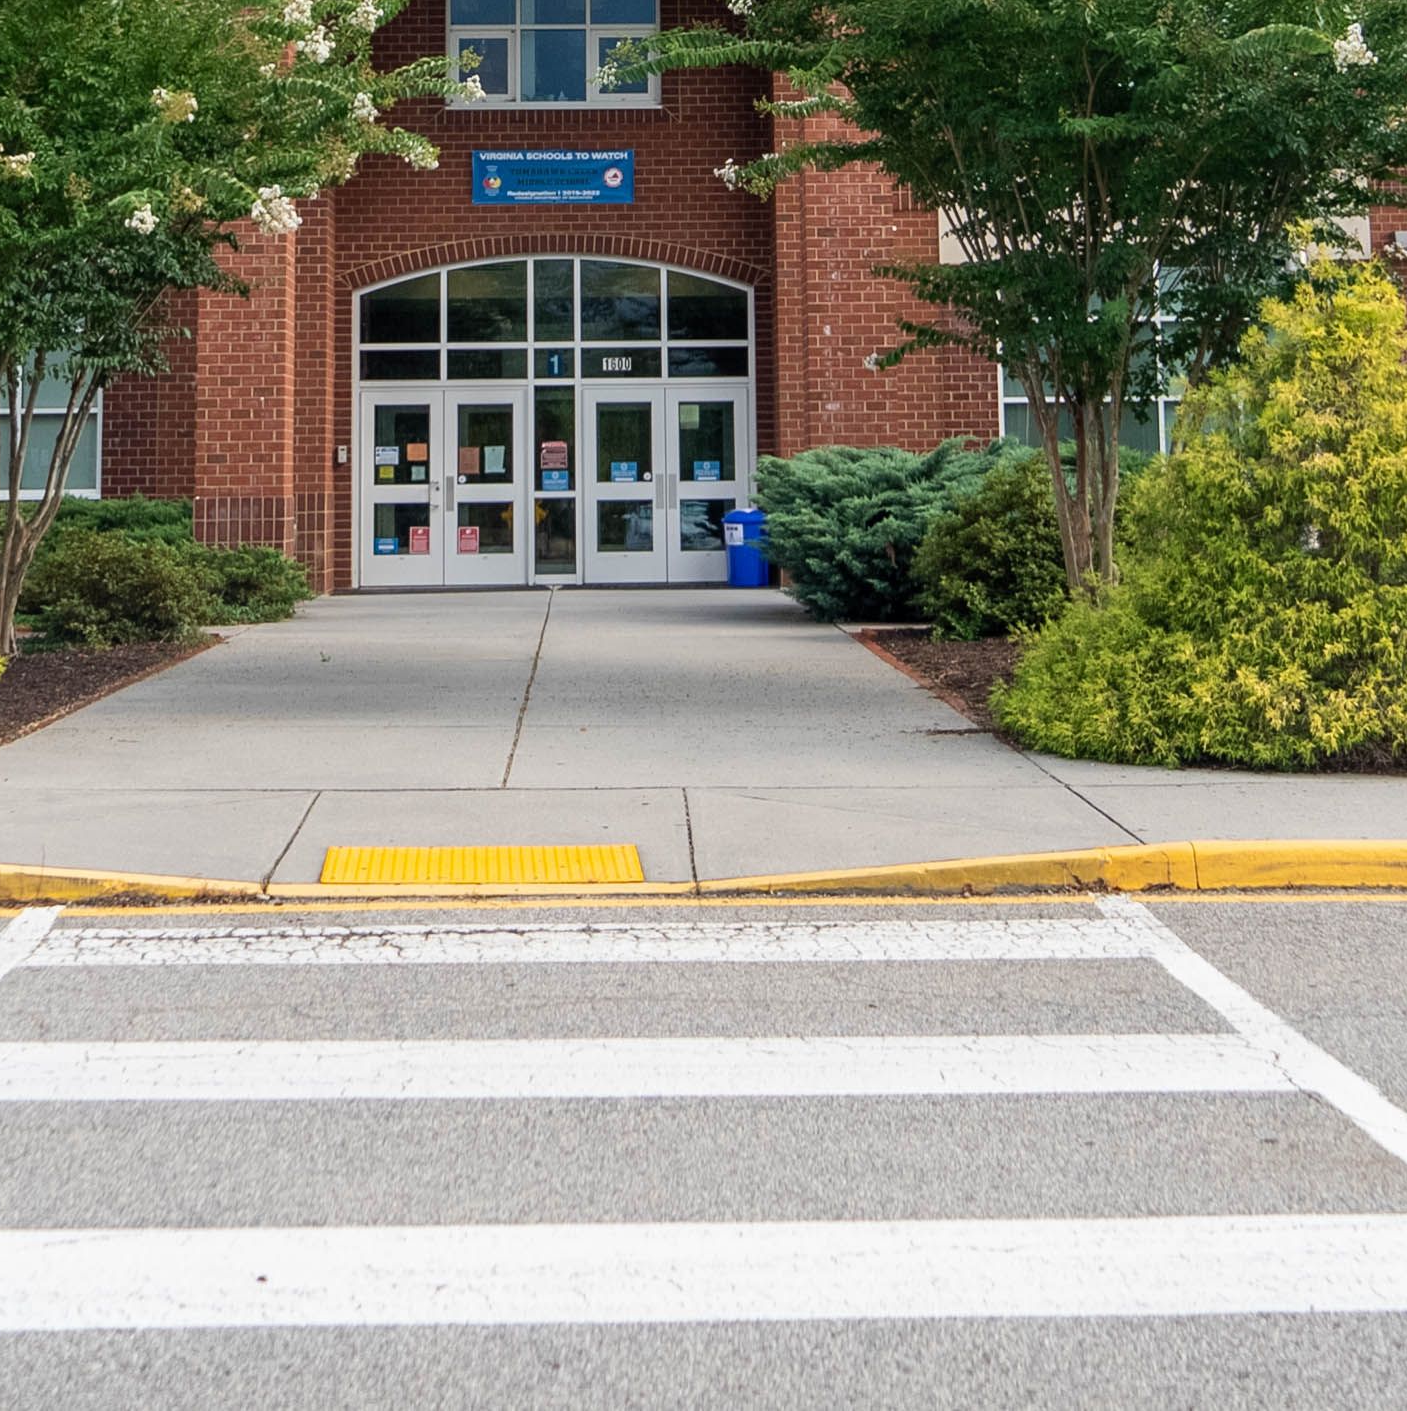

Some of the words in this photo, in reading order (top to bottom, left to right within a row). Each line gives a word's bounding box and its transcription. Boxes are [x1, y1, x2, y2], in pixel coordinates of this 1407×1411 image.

[480, 152, 524, 160] VIRGINIA
[526, 152, 573, 160] SCHOOLS
[576, 152, 589, 160] TO
[592, 152, 628, 160] WATCH
[550, 355, 559, 374] 1
[603, 357, 632, 371] 1600
